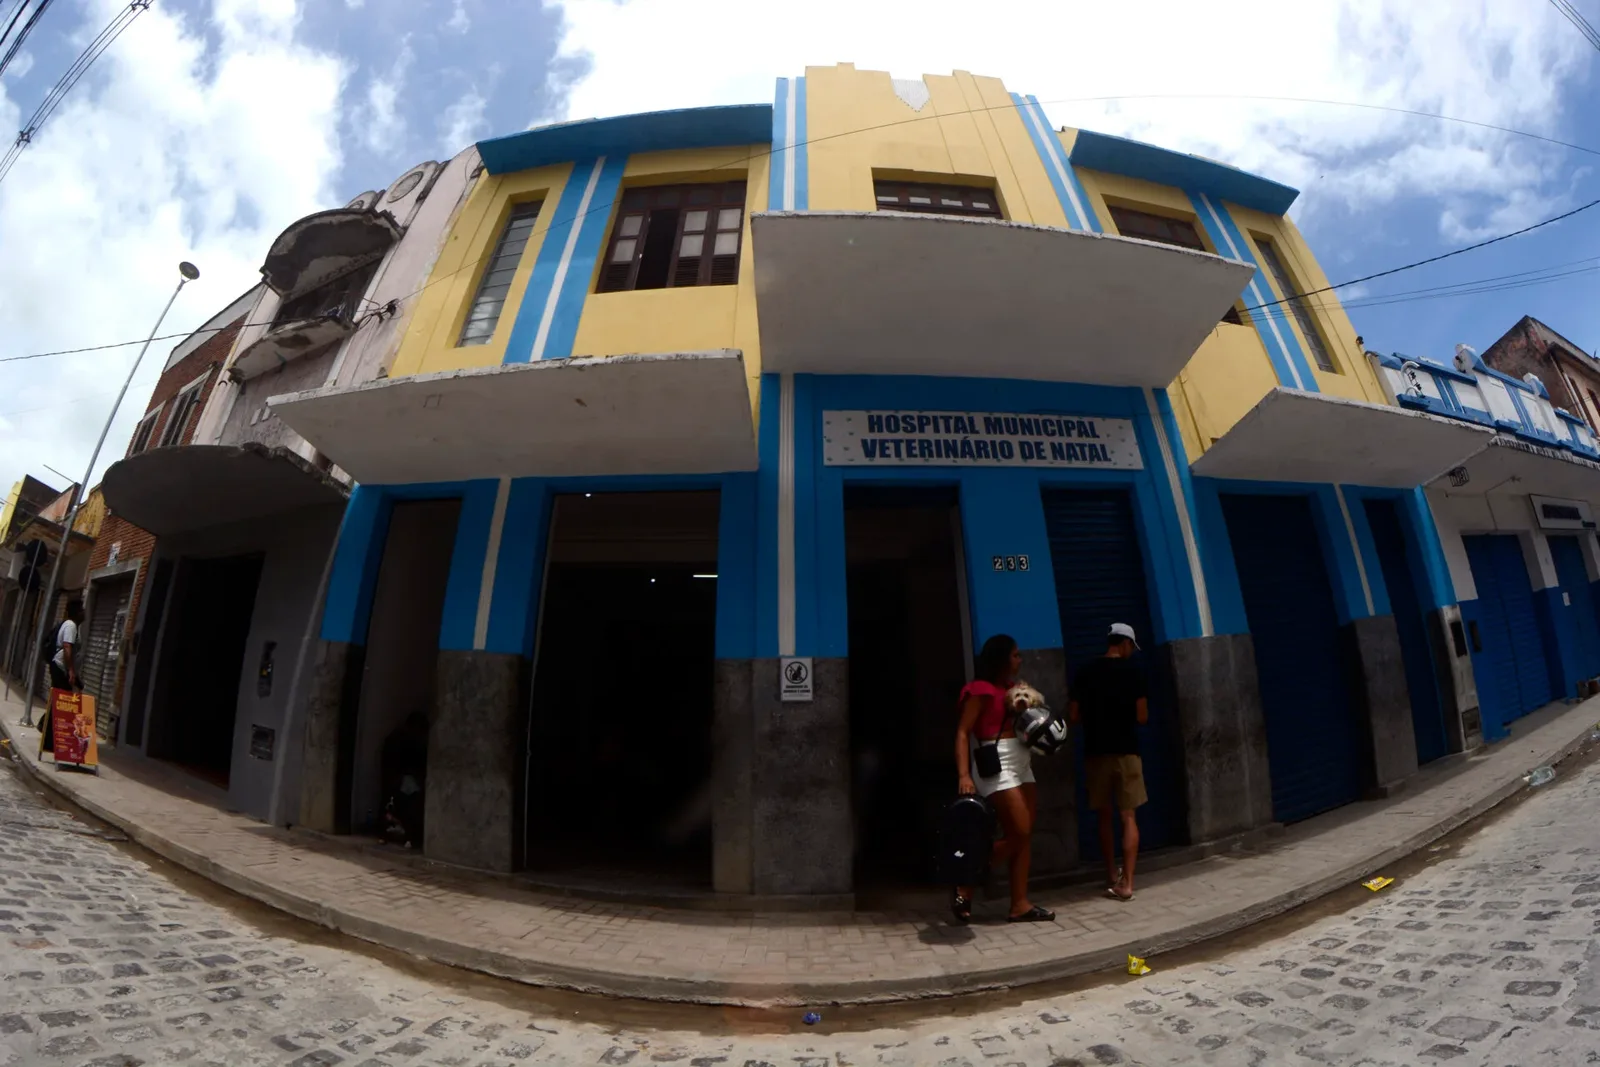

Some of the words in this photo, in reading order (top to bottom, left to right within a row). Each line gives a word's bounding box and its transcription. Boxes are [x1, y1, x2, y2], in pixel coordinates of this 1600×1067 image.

[867, 414, 980, 434] HOSPITAL
[984, 416, 1100, 438] MUNICIPAL
[861, 436, 1014, 459] VETERINÁRIO
[1019, 440, 1047, 460] DE
[1050, 442, 1112, 462] NATAL
[993, 556, 1029, 571] 233
